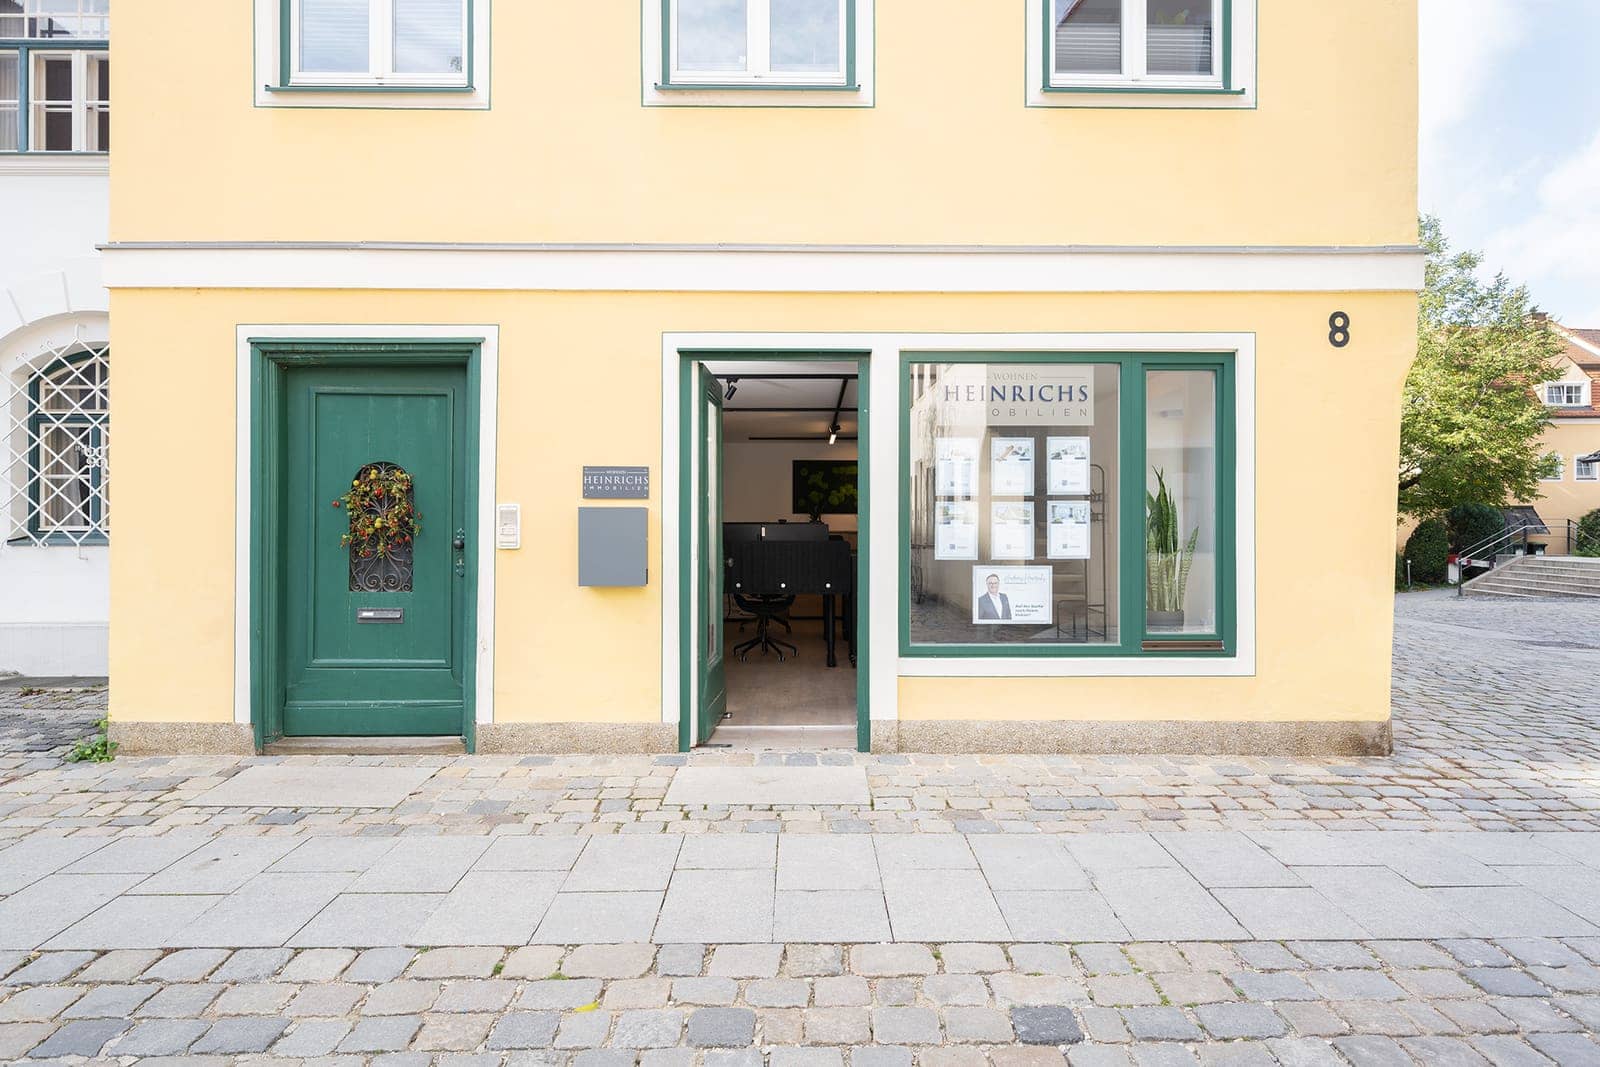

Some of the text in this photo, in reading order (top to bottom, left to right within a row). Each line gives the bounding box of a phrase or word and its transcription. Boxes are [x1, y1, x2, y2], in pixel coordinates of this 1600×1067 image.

[1329, 311, 1350, 348] 8
[993, 372, 1039, 381] WOHNEN
[944, 384, 1088, 402] HEINRICHS
[991, 408, 1088, 417] OBILIEN
[584, 475, 649, 485] HEINRICHS
